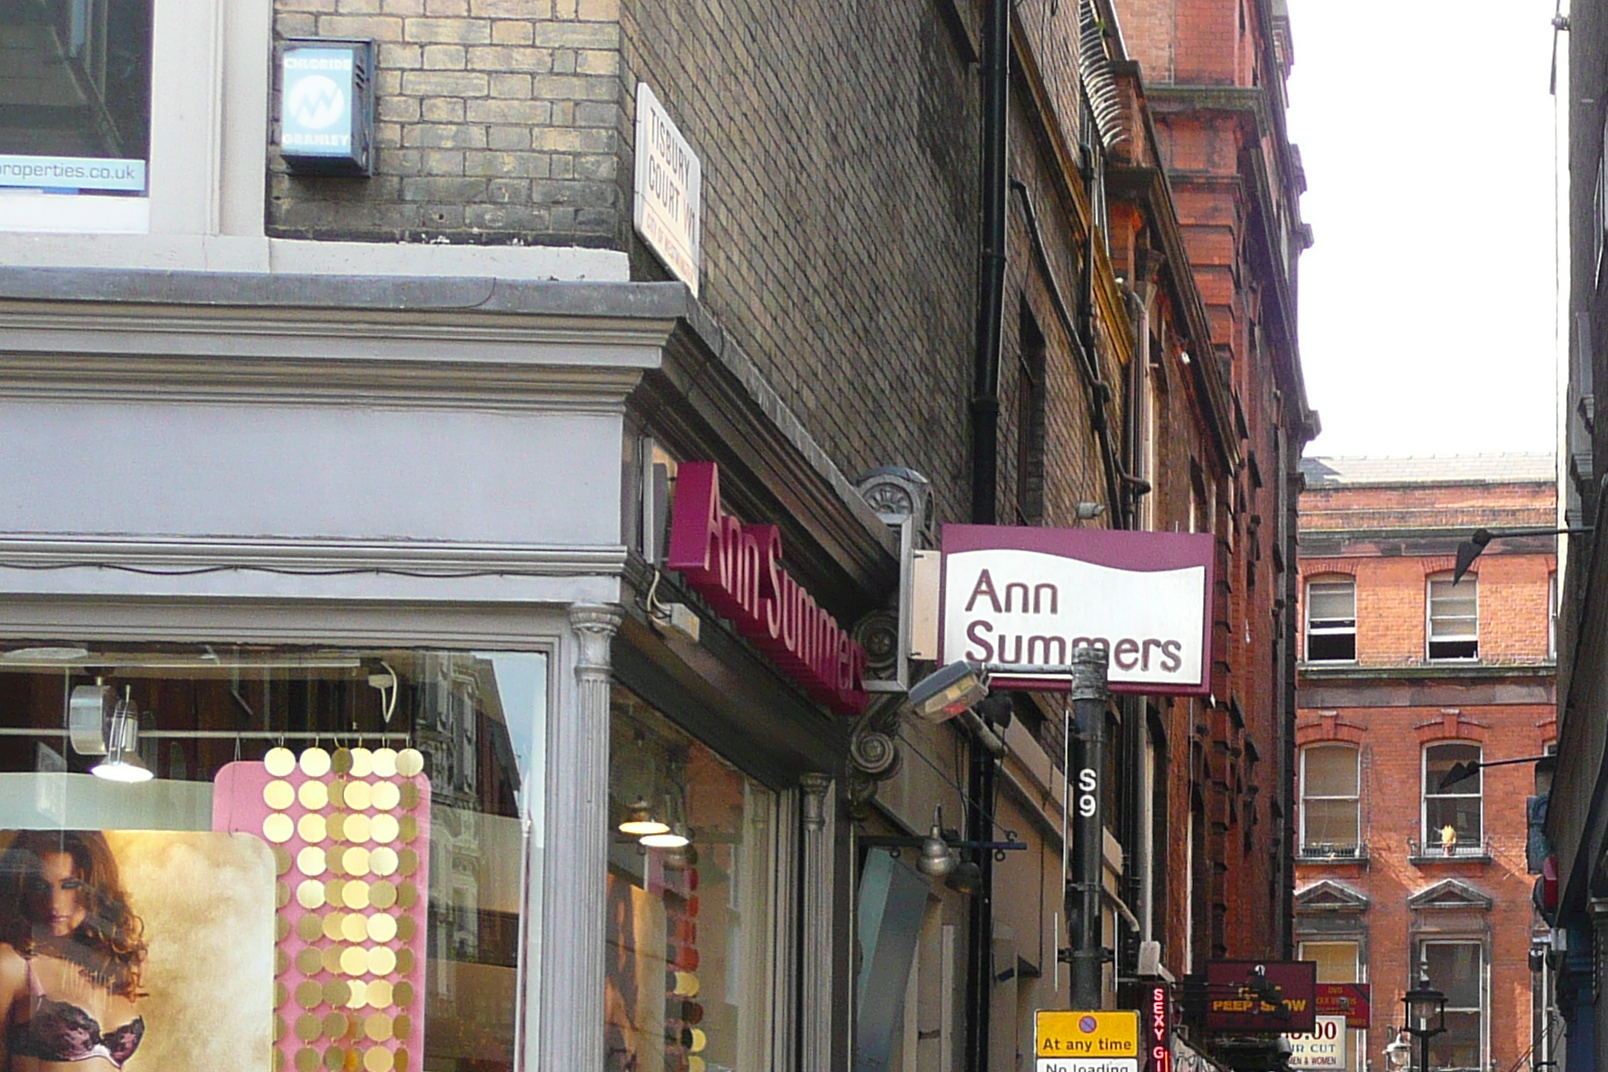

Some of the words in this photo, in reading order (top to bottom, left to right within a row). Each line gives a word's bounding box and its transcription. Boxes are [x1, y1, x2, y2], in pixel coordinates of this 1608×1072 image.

[284, 58, 352, 70] CHLORIDE
[650, 107, 691, 191] TISBURY
[0, 163, 135, 180] roperties.co.uk
[648, 154, 681, 223] COURT
[964, 568, 1058, 615] Ann
[1213, 1001, 1253, 1011] PEEP
[1153, 988, 1166, 1042] SEXY
[1043, 1038, 1061, 1051] At
[1066, 1040, 1092, 1052] any
[1099, 1038, 1132, 1051] time
[1310, 1043, 1336, 1053] CUT
[1312, 1056, 1336, 1065] WOMEN
